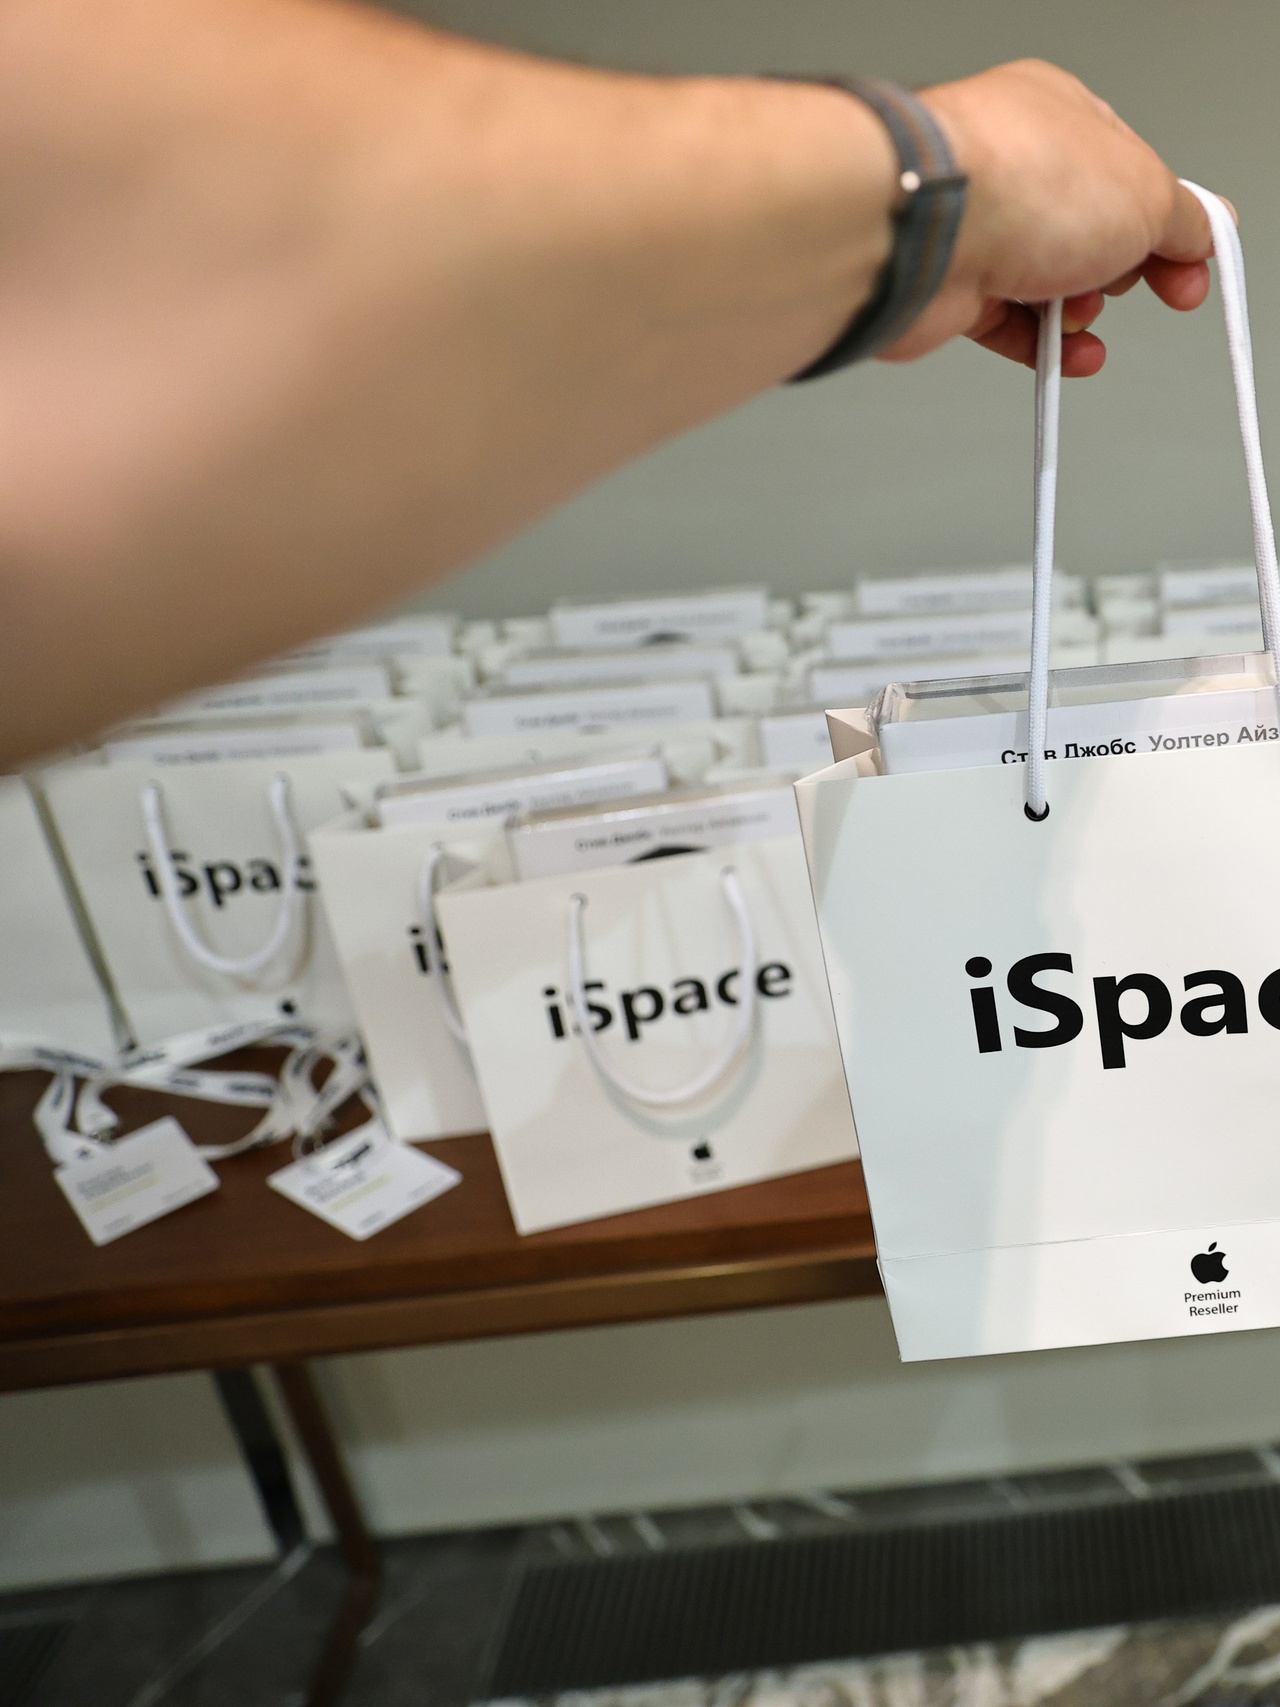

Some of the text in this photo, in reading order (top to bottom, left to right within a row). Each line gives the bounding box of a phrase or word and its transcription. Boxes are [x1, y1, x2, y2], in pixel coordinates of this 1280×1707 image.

[1001, 749, 1057, 764] Ств
[1064, 738, 1137, 760] Джобс
[1148, 730, 1230, 752] Уолтер
[1184, 1289, 1241, 1303] Premium
[1189, 1303, 1239, 1317] Reseller
